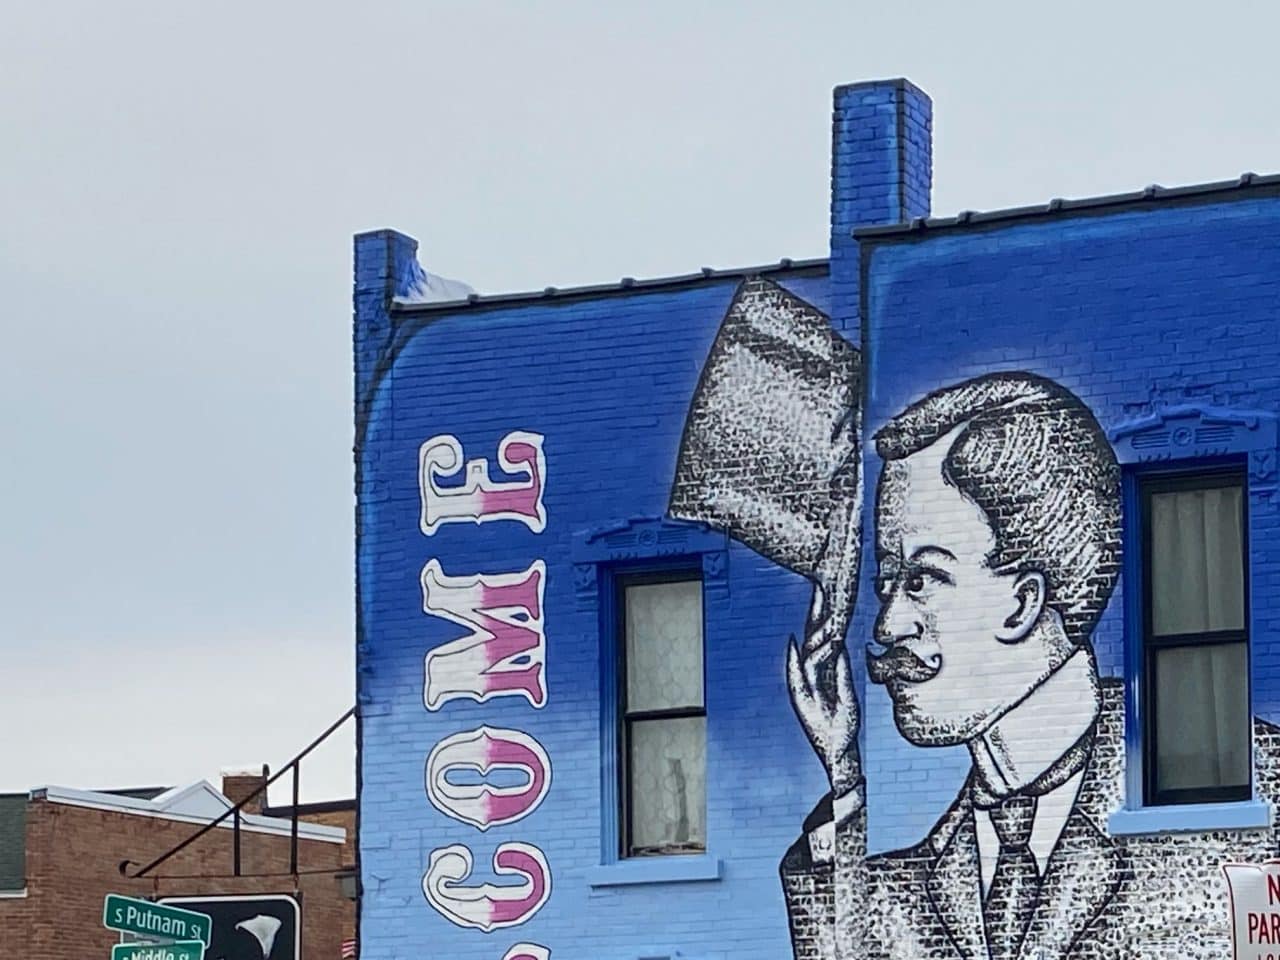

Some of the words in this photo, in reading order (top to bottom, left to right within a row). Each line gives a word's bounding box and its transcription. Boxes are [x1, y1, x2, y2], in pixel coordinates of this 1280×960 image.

[115, 908, 123, 924] S
[126, 906, 186, 937] Putnam
[190, 924, 202, 939] St
